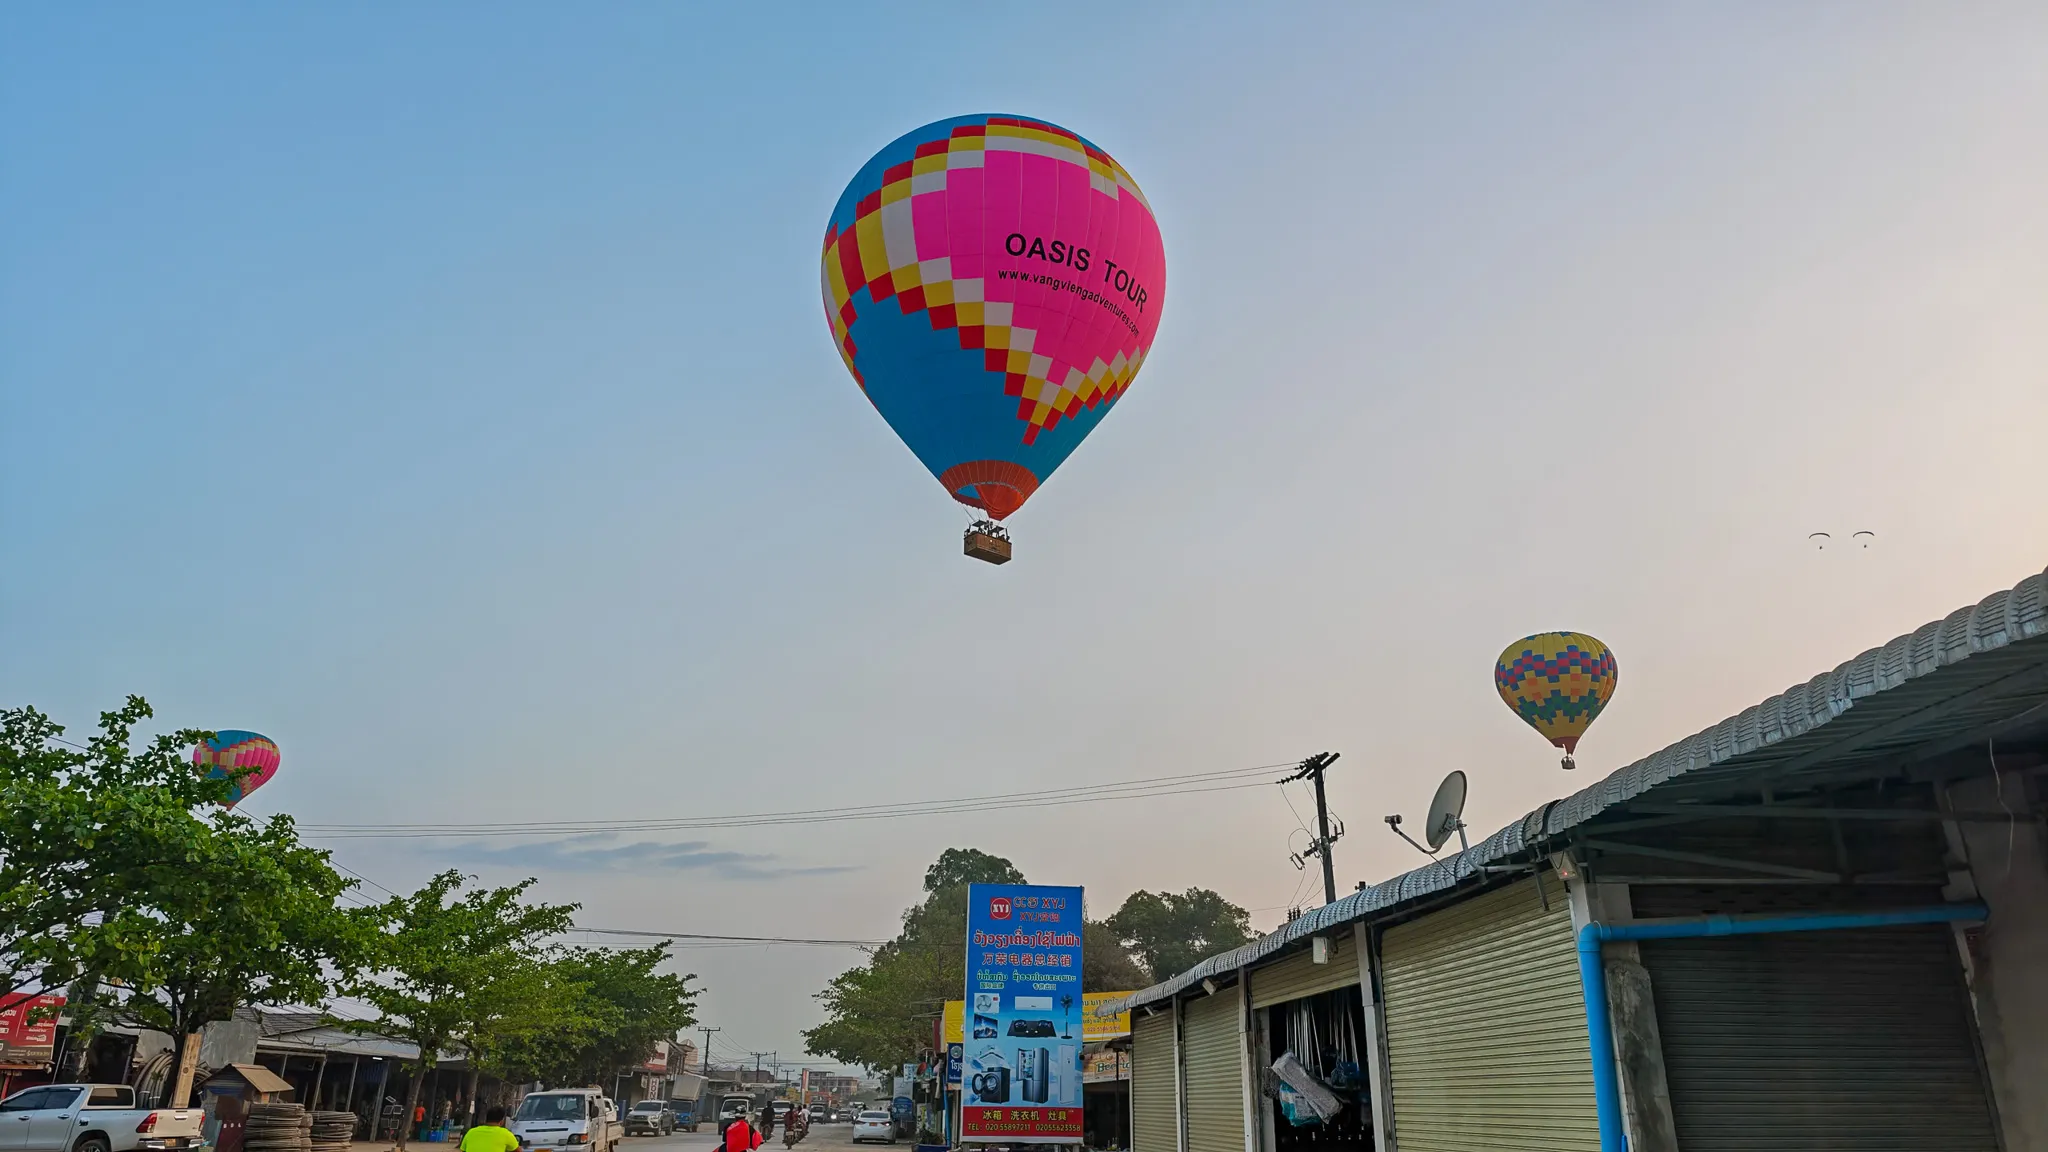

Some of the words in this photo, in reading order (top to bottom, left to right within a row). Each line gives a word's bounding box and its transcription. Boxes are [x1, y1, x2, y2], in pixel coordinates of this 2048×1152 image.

[1005, 233, 1090, 272] OASIS
[1104, 259, 1148, 313] TOUR
[998, 269, 1140, 338] www.vangviengadventures.com
[993, 903, 1009, 913] XYJ
[1041, 897, 1066, 910] XYJ
[982, 953, 1072, 967] 万荣电器总经销
[982, 1110, 1002, 1121] 冰箱
[1010, 1110, 1040, 1121] 洗衣机
